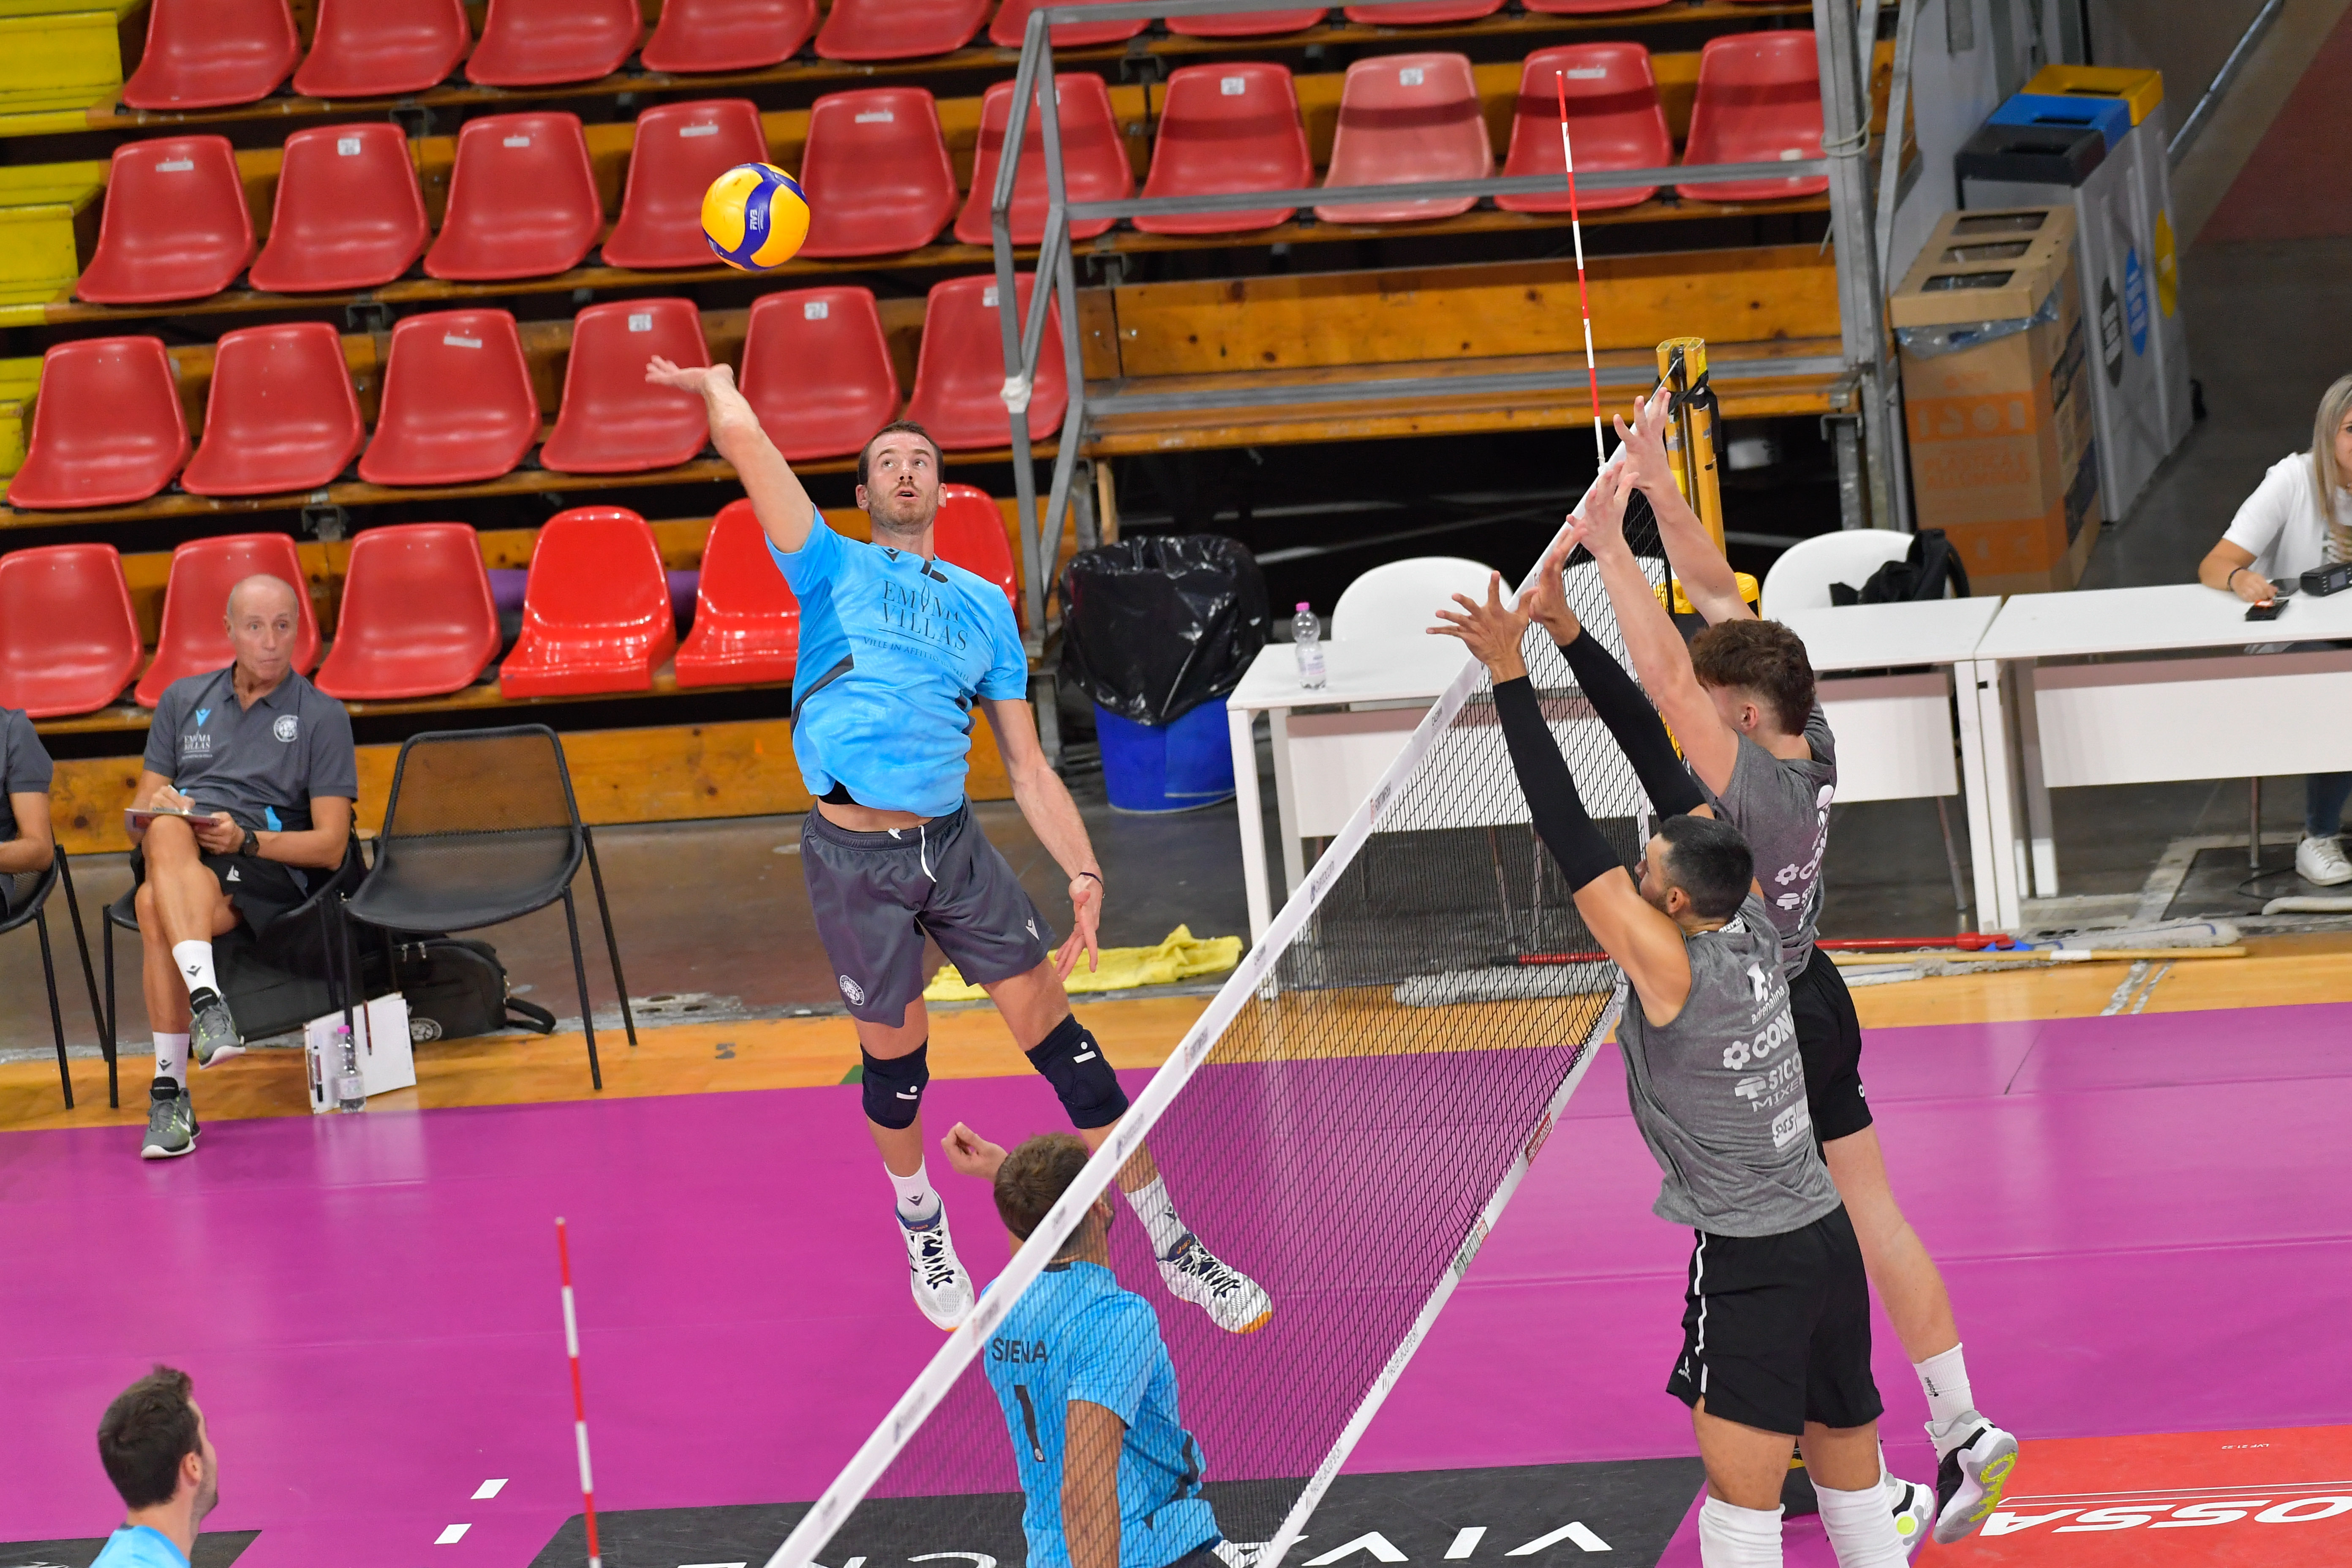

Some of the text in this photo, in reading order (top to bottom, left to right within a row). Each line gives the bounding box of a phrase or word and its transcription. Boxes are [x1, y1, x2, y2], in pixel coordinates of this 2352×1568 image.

[881, 602, 968, 651] VILLAS
[863, 637, 887, 649] VILLE
[904, 647, 939, 662] AFFITTO
[1751, 985, 1785, 1024] adrenalina
[991, 1337, 1048, 1363] SIENA
[1014, 1385, 1045, 1463] 1
